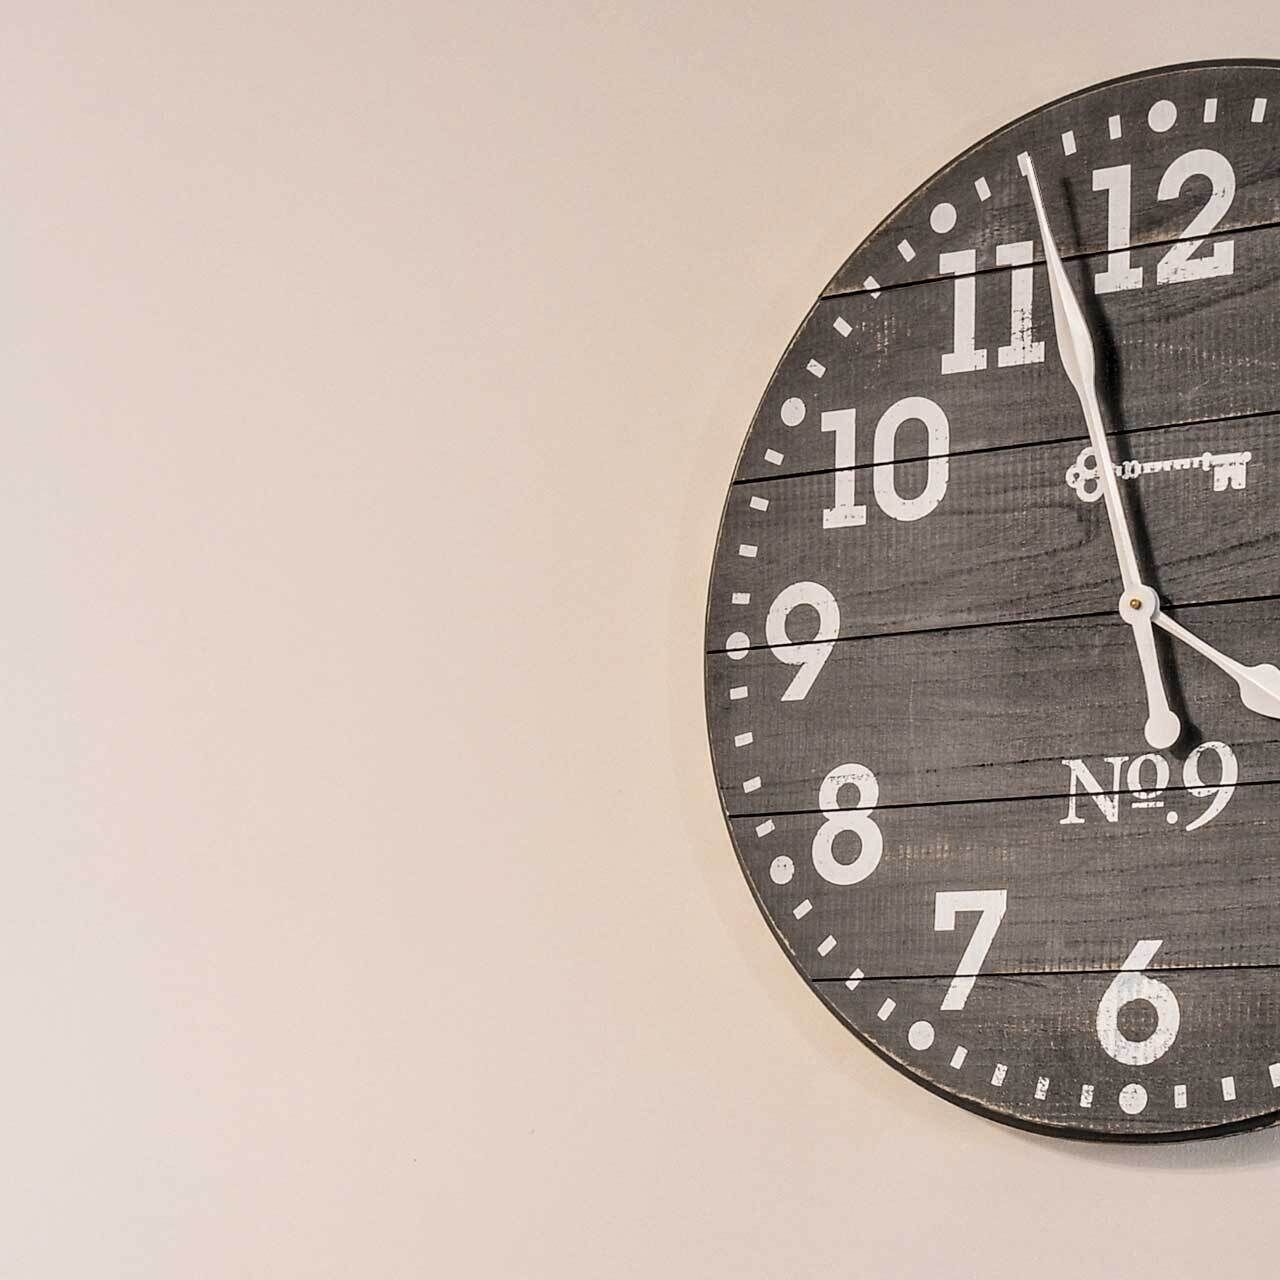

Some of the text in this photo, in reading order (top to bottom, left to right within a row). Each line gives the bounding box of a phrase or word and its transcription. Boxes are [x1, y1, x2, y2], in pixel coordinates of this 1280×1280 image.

[1093, 149, 1235, 294] 12
[939, 240, 1046, 375] 11
[821, 397, 949, 529] 10
[766, 582, 840, 701] 9
[812, 764, 883, 885] 8
[934, 890, 1007, 1010] 7
[1096, 940, 1180, 1065] 6
